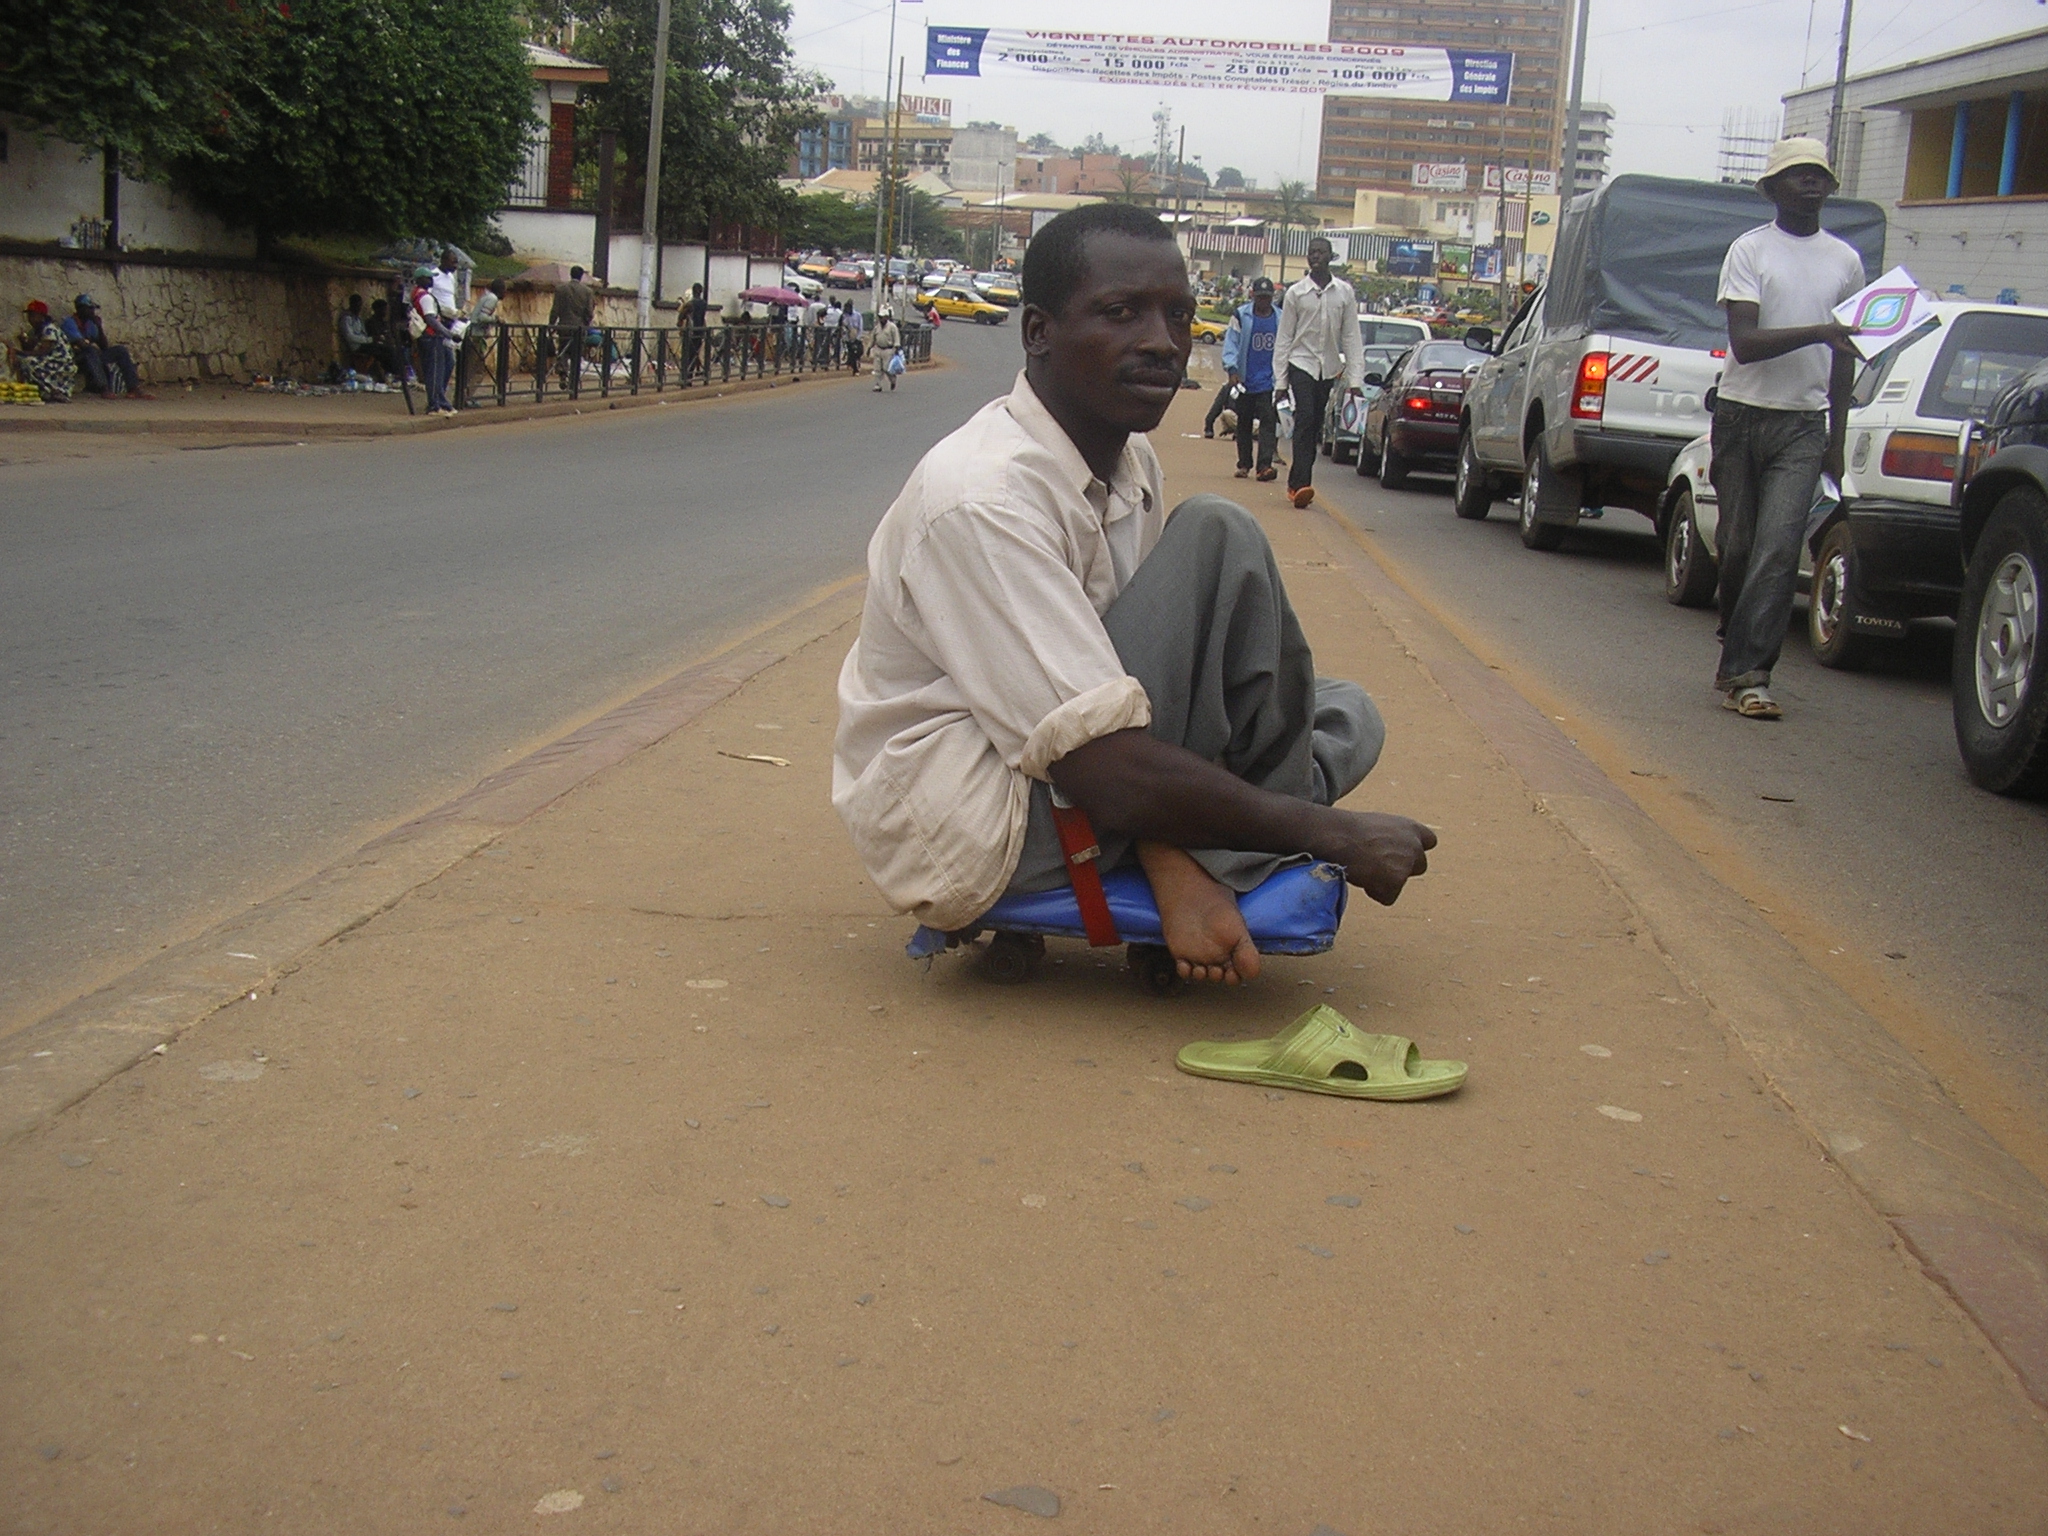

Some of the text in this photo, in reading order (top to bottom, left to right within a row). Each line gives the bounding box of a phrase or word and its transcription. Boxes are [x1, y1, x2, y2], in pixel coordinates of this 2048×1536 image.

[937, 34, 972, 45] Ministère
[1026, 31, 1404, 56] VIGNETTES AUTOMOBILES 2009
[947, 48, 960, 56] des
[1118, 45, 1165, 53] VÉHICULES
[936, 59, 970, 69] Finances
[997, 53, 1008, 61] 2
[1016, 53, 1048, 64] 000
[1104, 58, 1124, 68] 15
[1132, 59, 1164, 69] 000
[1226, 64, 1248, 74] 25
[1256, 65, 1289, 76] 000
[1331, 69, 1364, 79] 100
[1372, 71, 1406, 81] 000
[1464, 58, 1498, 69] Direction
[1092, 68, 1131, 76] Recettes
[1191, 73, 1222, 81] Postes
[1224, 75, 1278, 84] Comptables
[1099, 76, 1160, 86] EXIGIBLES
[1464, 71, 1496, 82] Générale
[1460, 84, 1472, 94] des
[900, 95, 951, 115] NIKI
[1429, 163, 1461, 177] Casino
[1505, 169, 1551, 182] Casno
[1252, 332, 1275, 351] 08
[1854, 615, 1902, 630] TOYOTA
